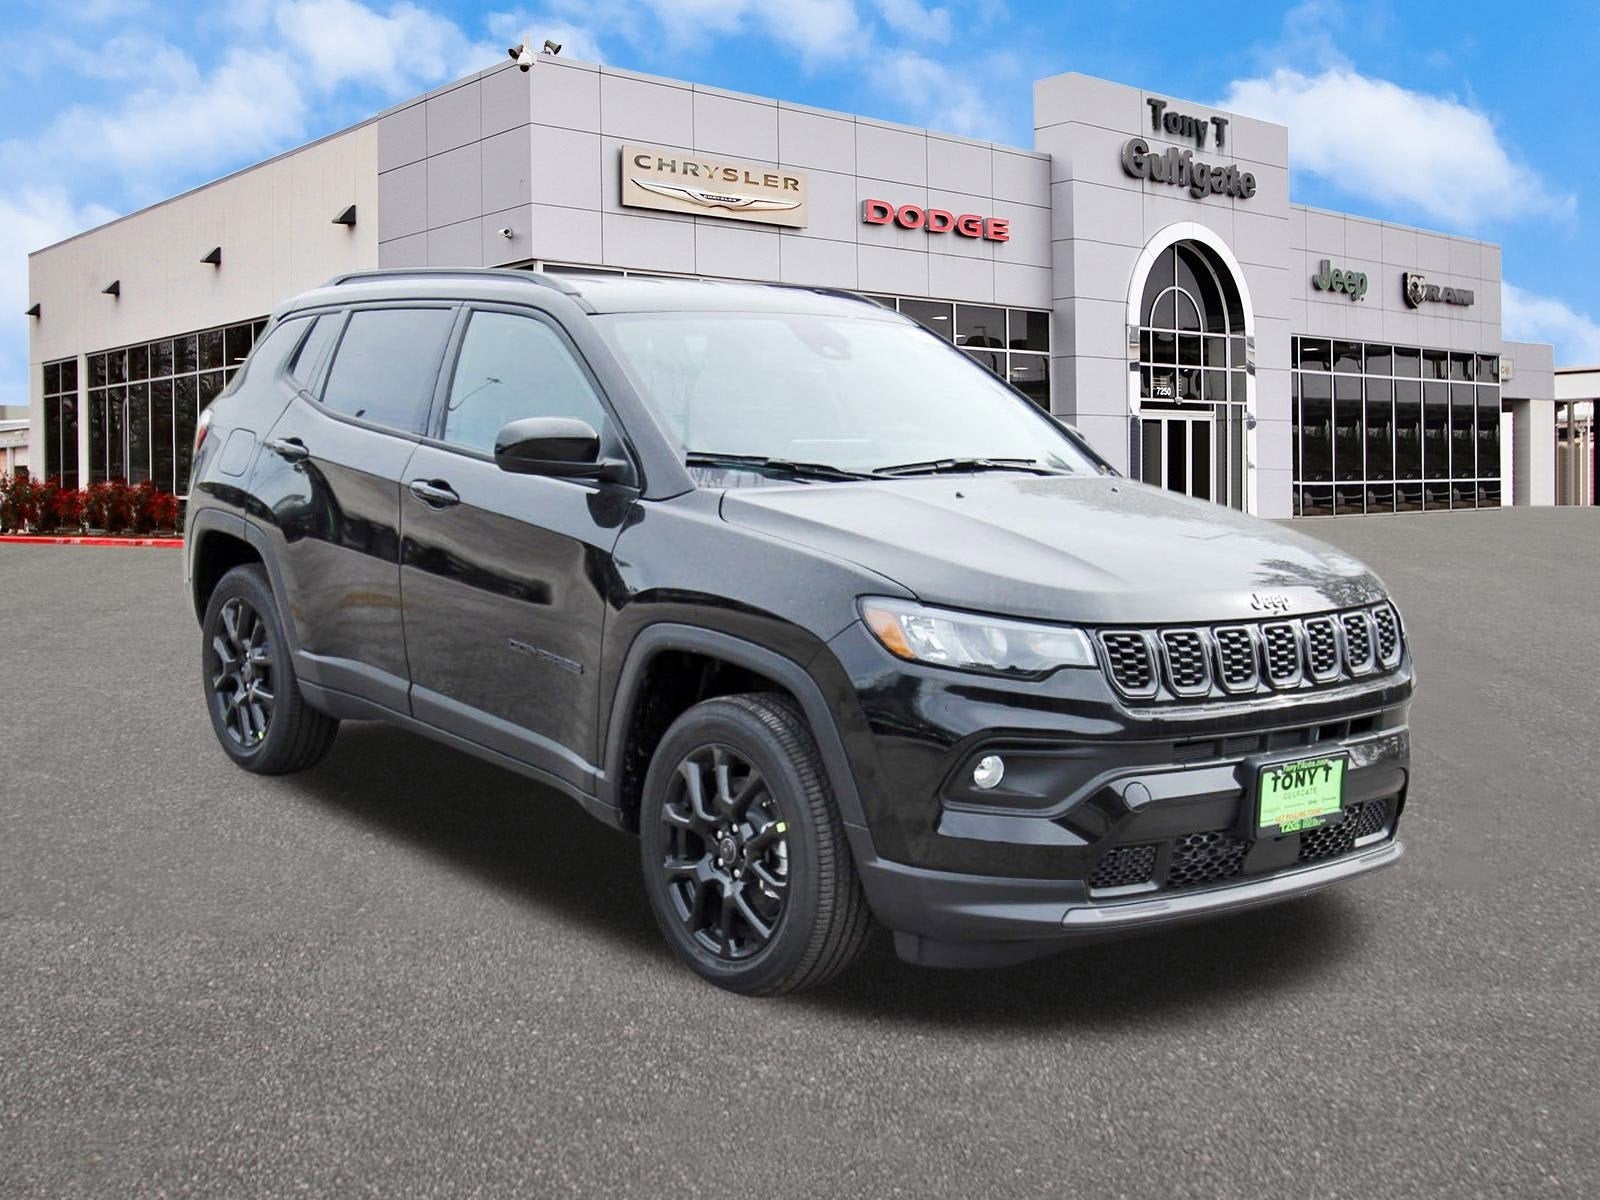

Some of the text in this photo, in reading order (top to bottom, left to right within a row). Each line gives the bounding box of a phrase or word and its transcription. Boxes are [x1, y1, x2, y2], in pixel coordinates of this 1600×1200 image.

[1146, 97, 1229, 147] Tony T
[633, 154, 800, 192] CHRYSLER
[1121, 137, 1256, 199] Gulfgate
[862, 198, 1010, 242] DODGE
[1312, 259, 1368, 301] Jeep
[1425, 283, 1475, 306] RAM
[1250, 592, 1289, 615] Jeep
[1271, 768, 1318, 793] TONY
[1322, 764, 1333, 783] T
